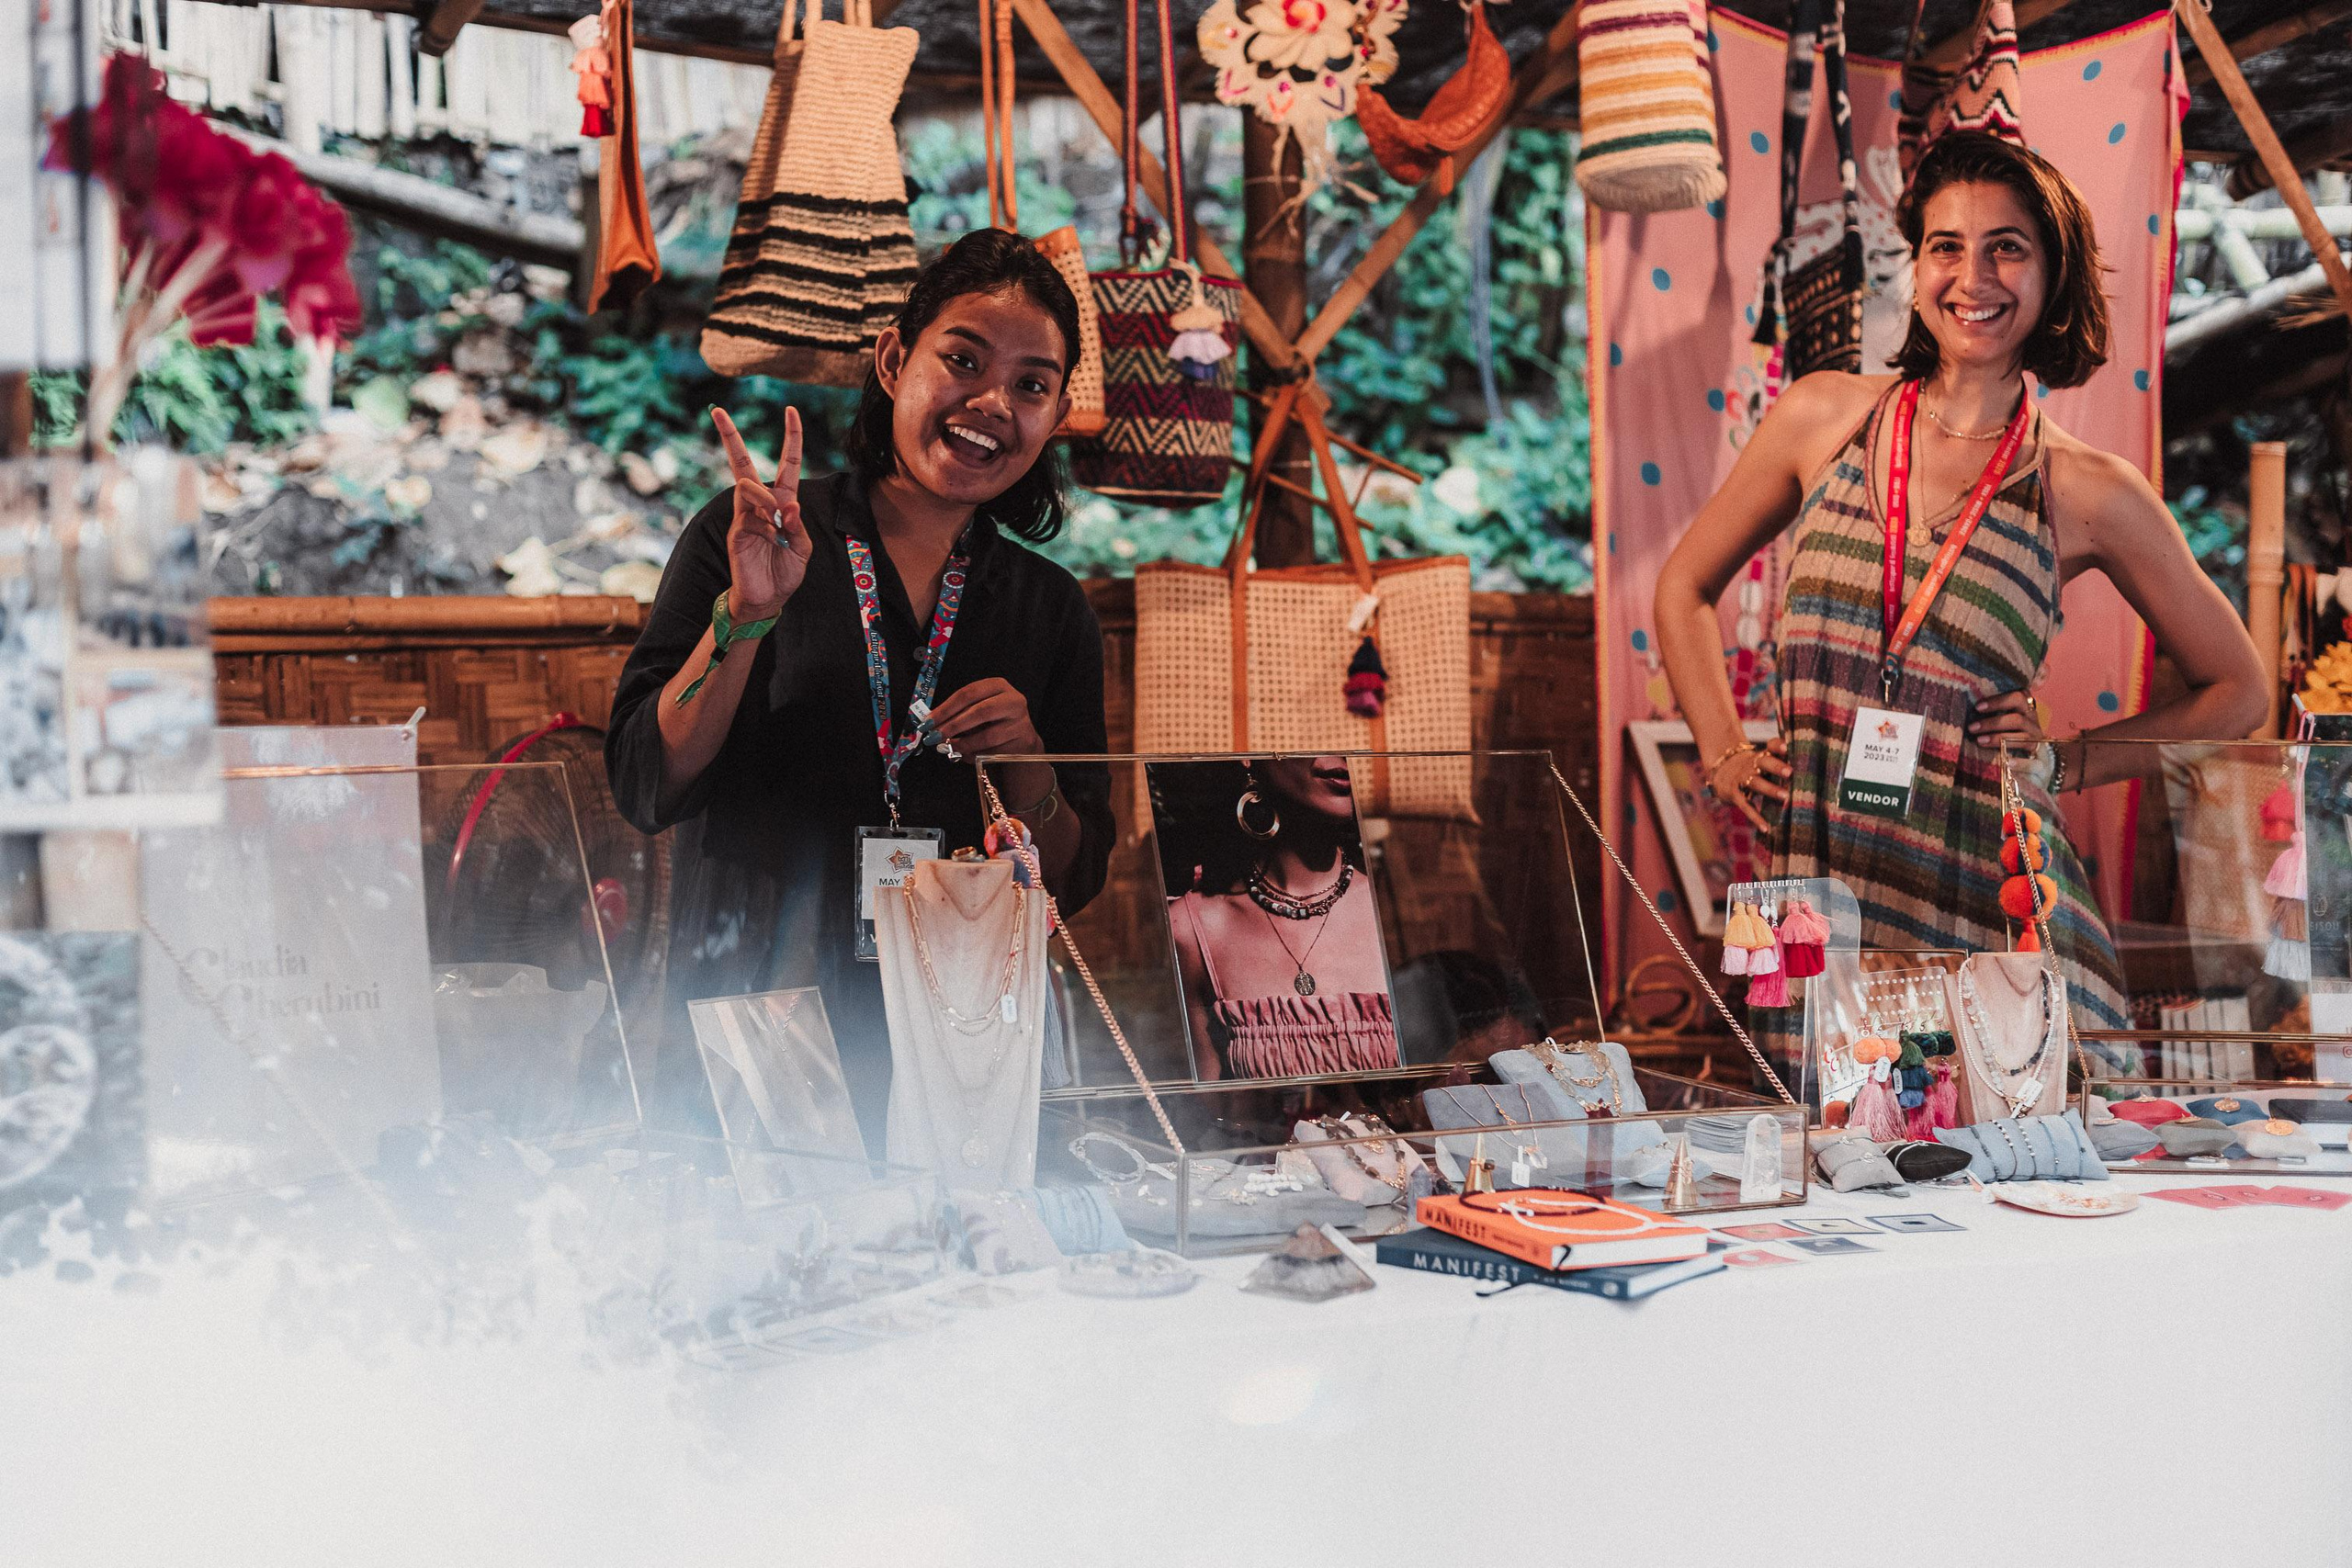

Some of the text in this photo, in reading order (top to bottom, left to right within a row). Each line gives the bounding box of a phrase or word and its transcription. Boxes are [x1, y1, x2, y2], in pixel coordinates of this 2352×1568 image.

[1863, 752, 1884, 761] 2023
[1864, 744, 1883, 754] MAY
[1848, 790, 1900, 807] VENDOR
[181, 944, 308, 985] Claudia
[220, 980, 381, 1021] Cherubini
[1424, 1207, 1487, 1241] MANIFEST
[1412, 1252, 1521, 1283] MANIFEST
